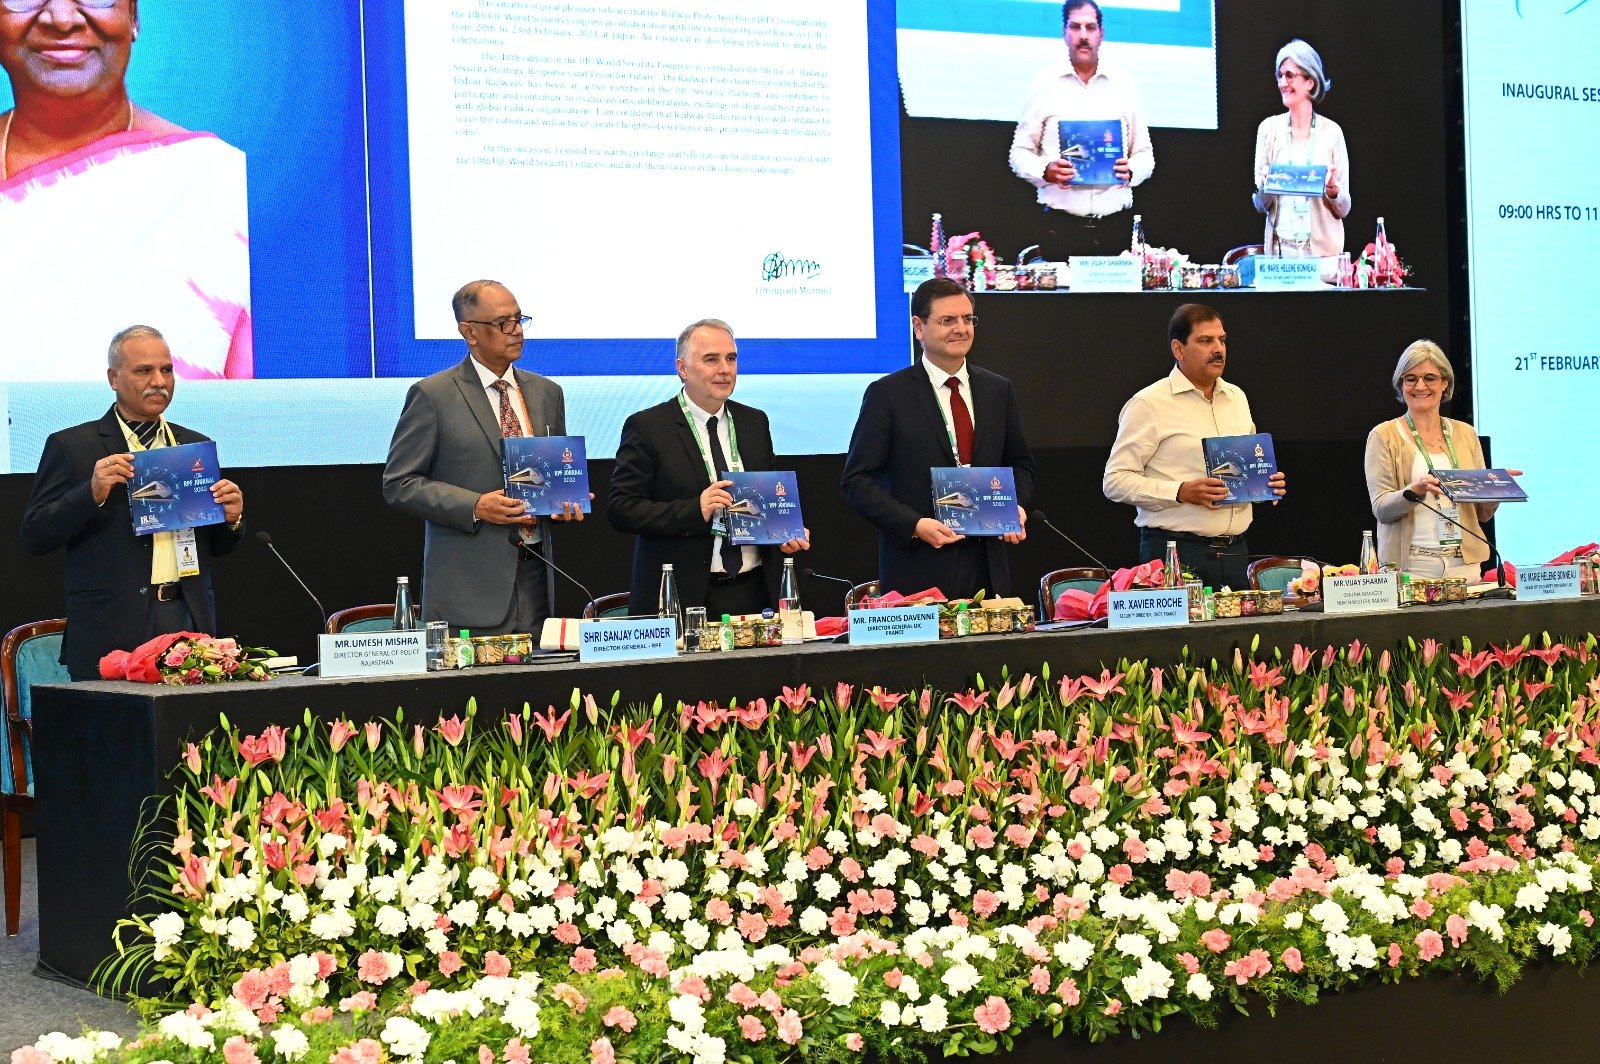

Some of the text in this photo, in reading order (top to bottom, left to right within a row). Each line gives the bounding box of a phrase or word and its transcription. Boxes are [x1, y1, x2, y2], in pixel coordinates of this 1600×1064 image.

[1502, 82, 1579, 100] INAUGURAL
[1499, 204, 1532, 218] 09:00
[1536, 205, 1561, 220] HRS
[1564, 206, 1581, 220] TO
[1540, 356, 1600, 370] FEBRUAR
[1113, 598, 1182, 610] MR. XAVIER ROCHE
[868, 615, 902, 624] FRANCOIS
[904, 613, 935, 622] DAVENNE
[386, 637, 419, 646] MISHRA
[584, 628, 671, 643] SHRI SANJAY CHANDER
